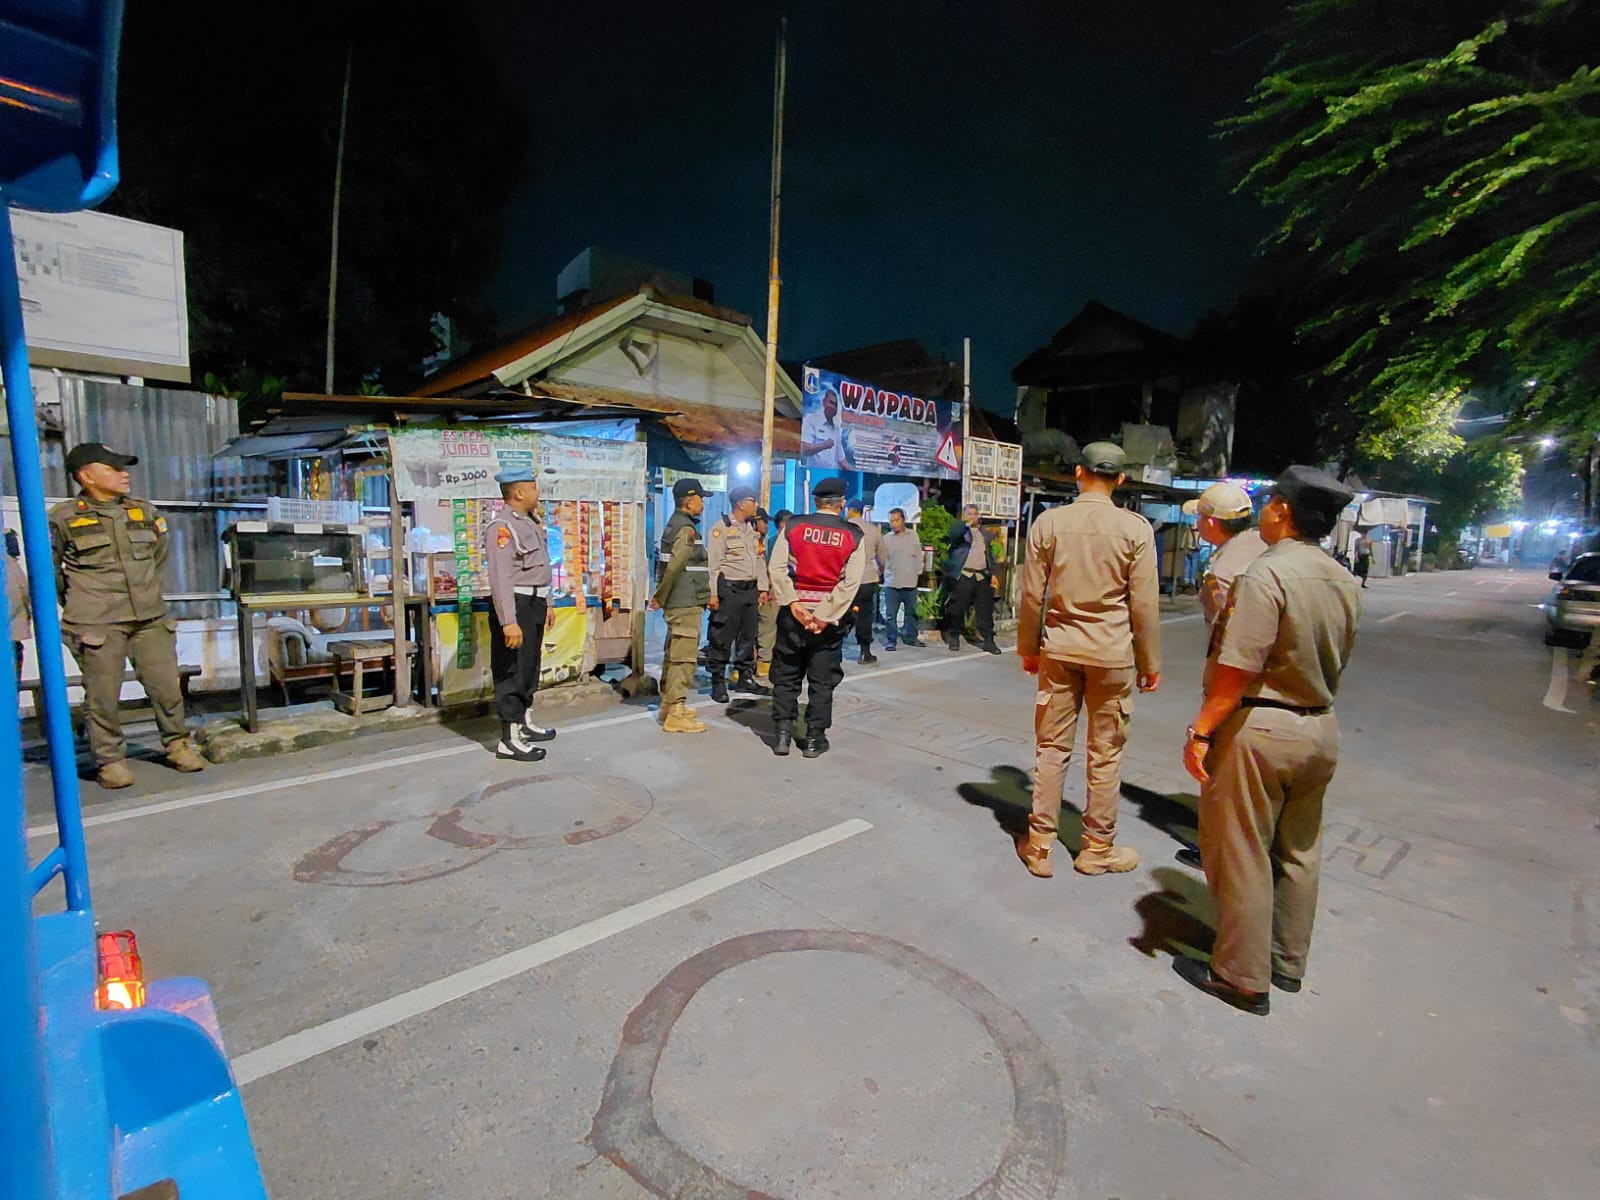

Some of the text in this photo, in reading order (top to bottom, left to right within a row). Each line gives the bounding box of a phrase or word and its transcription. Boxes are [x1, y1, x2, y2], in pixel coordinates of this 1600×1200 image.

[840, 381, 938, 427] WASPADA
[442, 431, 457, 441] ES
[439, 442, 490, 457] JUMBO
[445, 470, 487, 484] Rp 3000
[803, 527, 845, 547] POLISI
